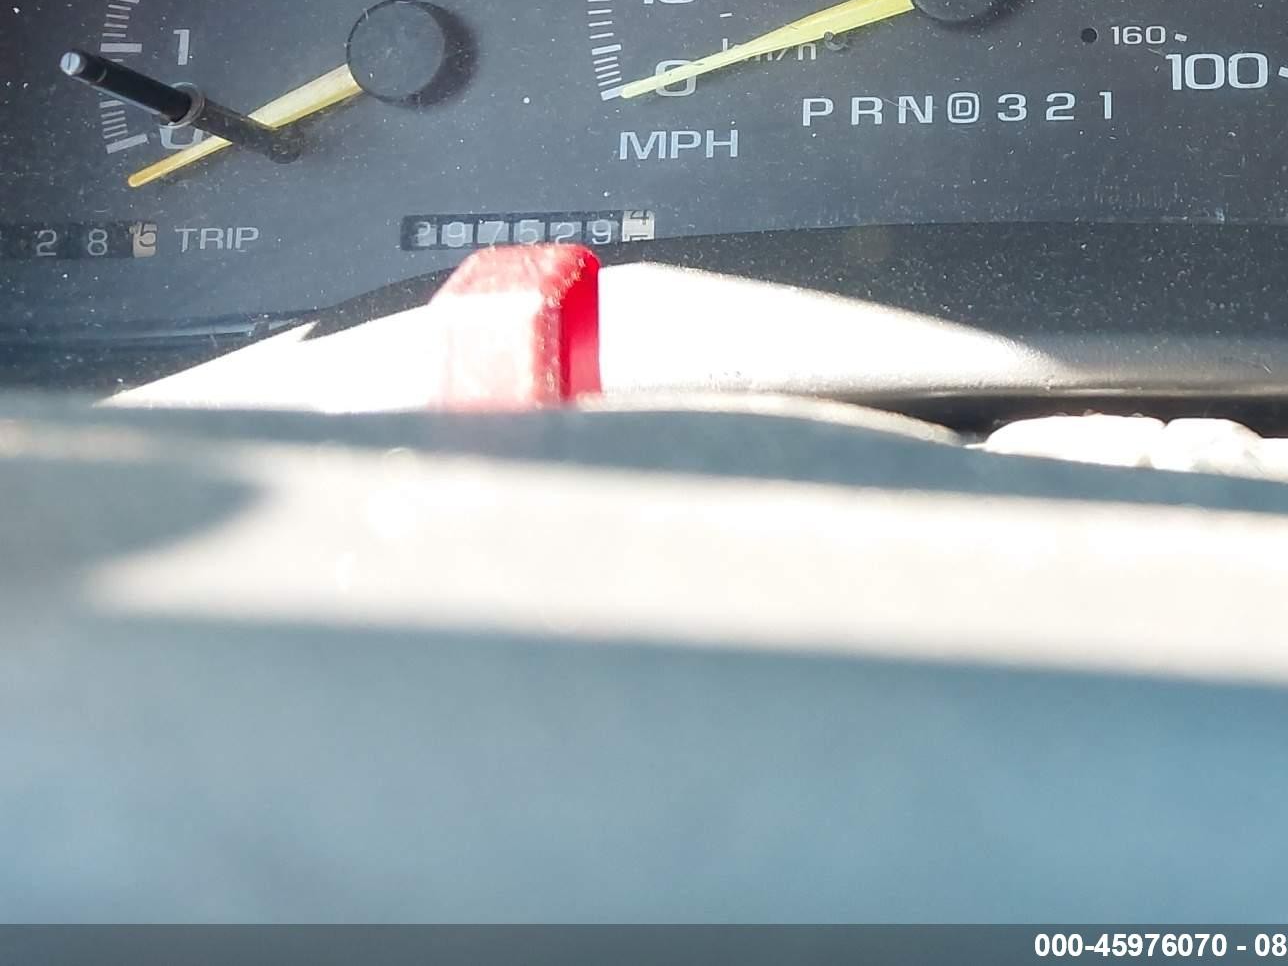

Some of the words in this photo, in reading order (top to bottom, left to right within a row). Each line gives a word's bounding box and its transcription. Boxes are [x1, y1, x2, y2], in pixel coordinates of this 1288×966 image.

[174, 30, 189, 65] 1
[1111, 26, 1165, 44] 160
[655, 59, 697, 96] 0
[1166, 53, 1268, 90] 100
[620, 130, 738, 159] MPH
[175, 227, 259, 252] TRIP
